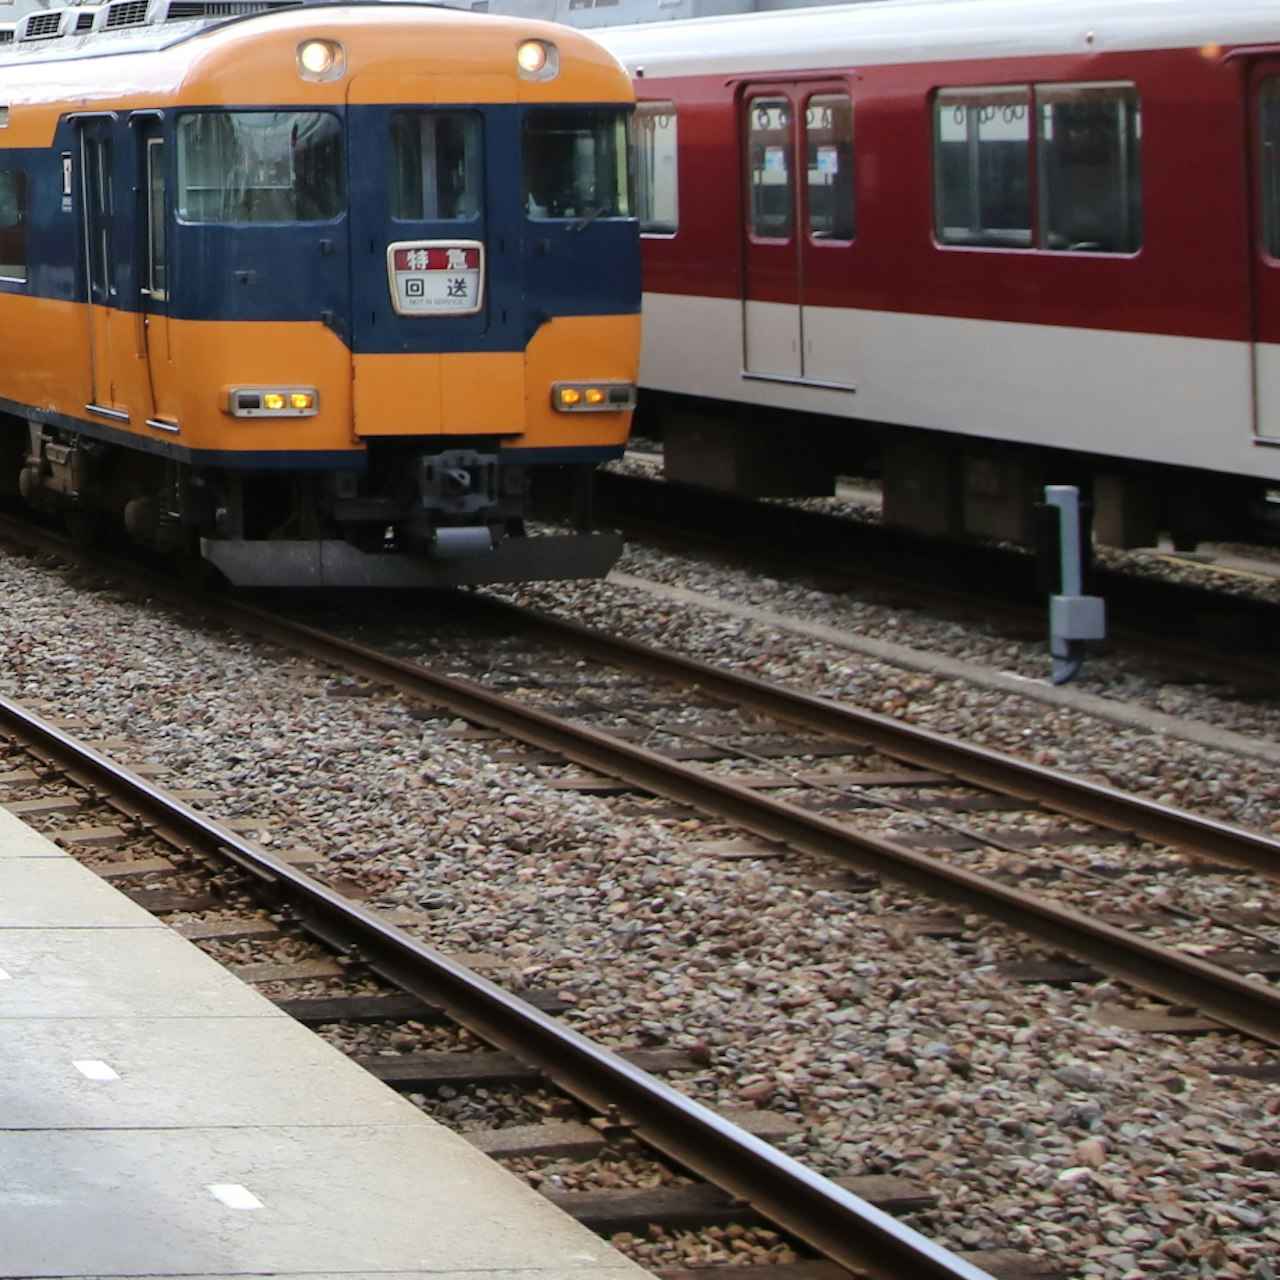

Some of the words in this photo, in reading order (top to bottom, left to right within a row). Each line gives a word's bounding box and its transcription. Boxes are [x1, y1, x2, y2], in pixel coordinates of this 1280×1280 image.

[406, 248, 469, 271] 特急
[405, 277, 469, 298] 回送
[409, 298, 424, 306] NOT
[434, 297, 464, 306] SERVICE
